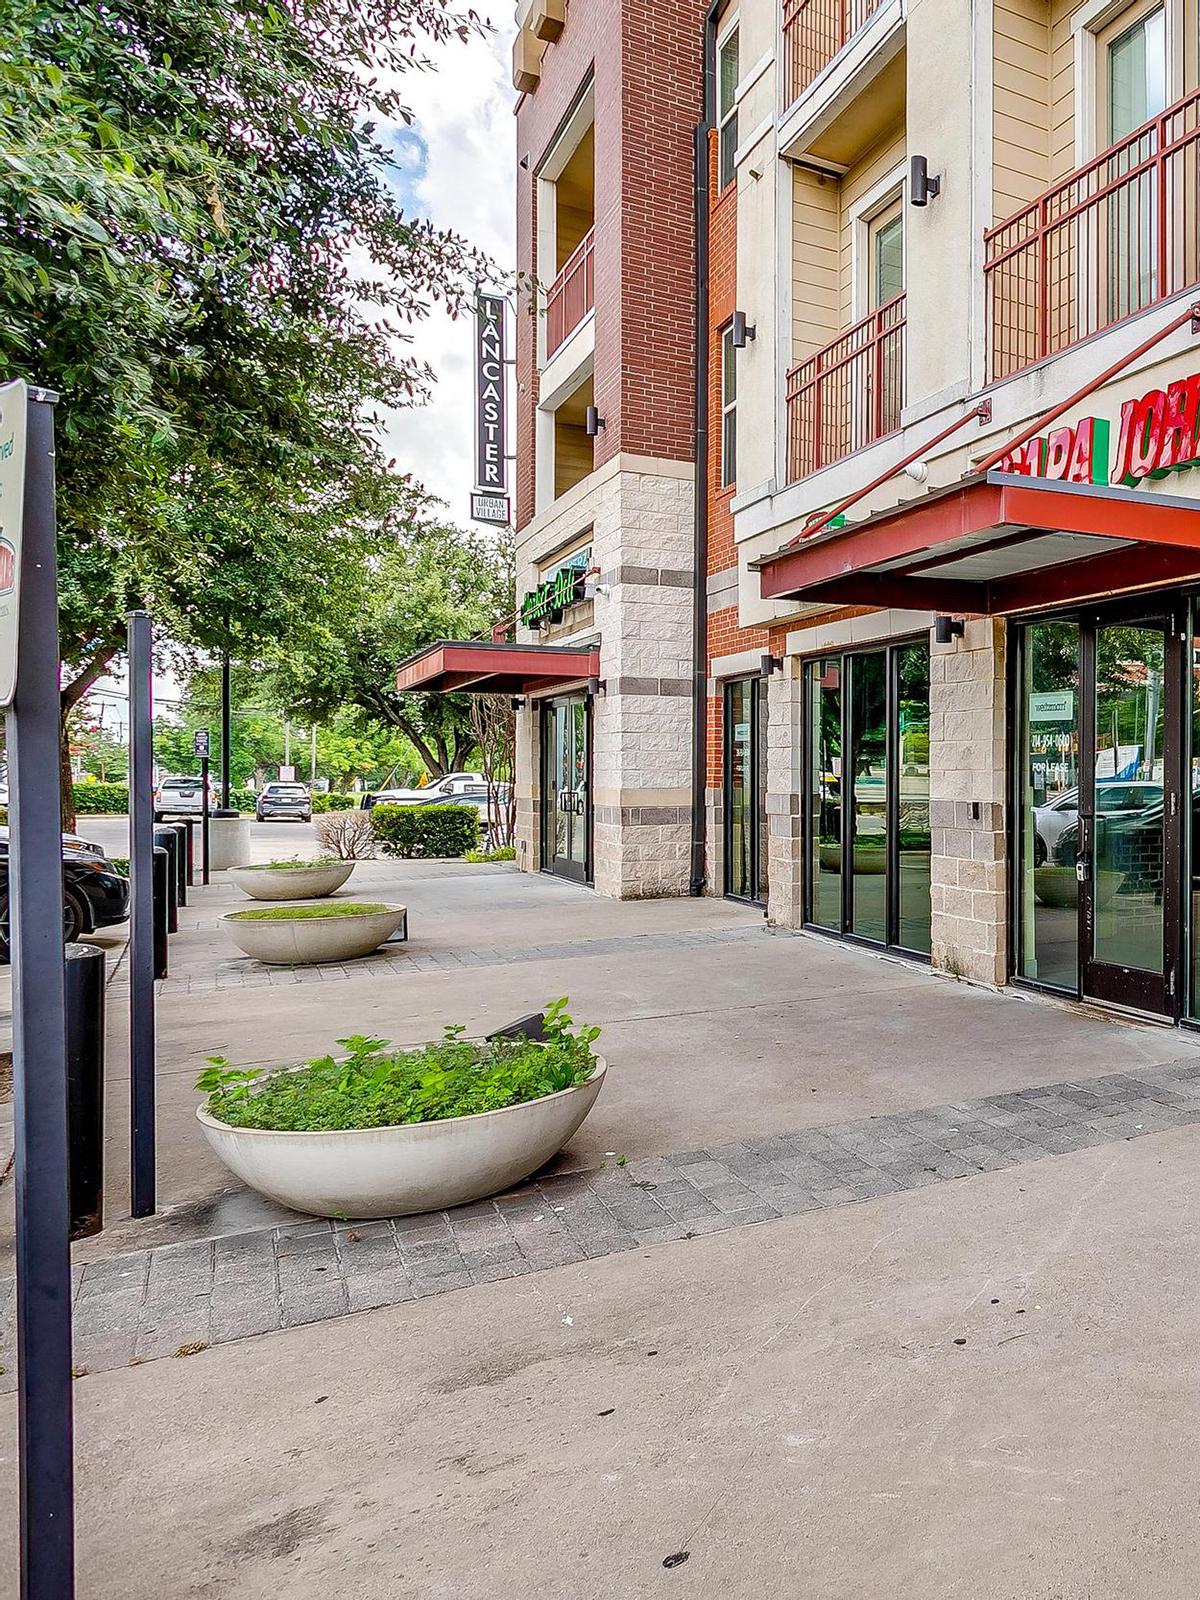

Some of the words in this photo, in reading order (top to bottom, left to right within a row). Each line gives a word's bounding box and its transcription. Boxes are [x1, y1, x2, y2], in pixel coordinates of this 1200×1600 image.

[481, 300, 501, 483] LANCASTER
[478, 497, 505, 509] URBAN
[476, 506, 506, 519] VILLAGE
[1032, 763, 1046, 772] FOR
[1048, 762, 1069, 772] LEASE
